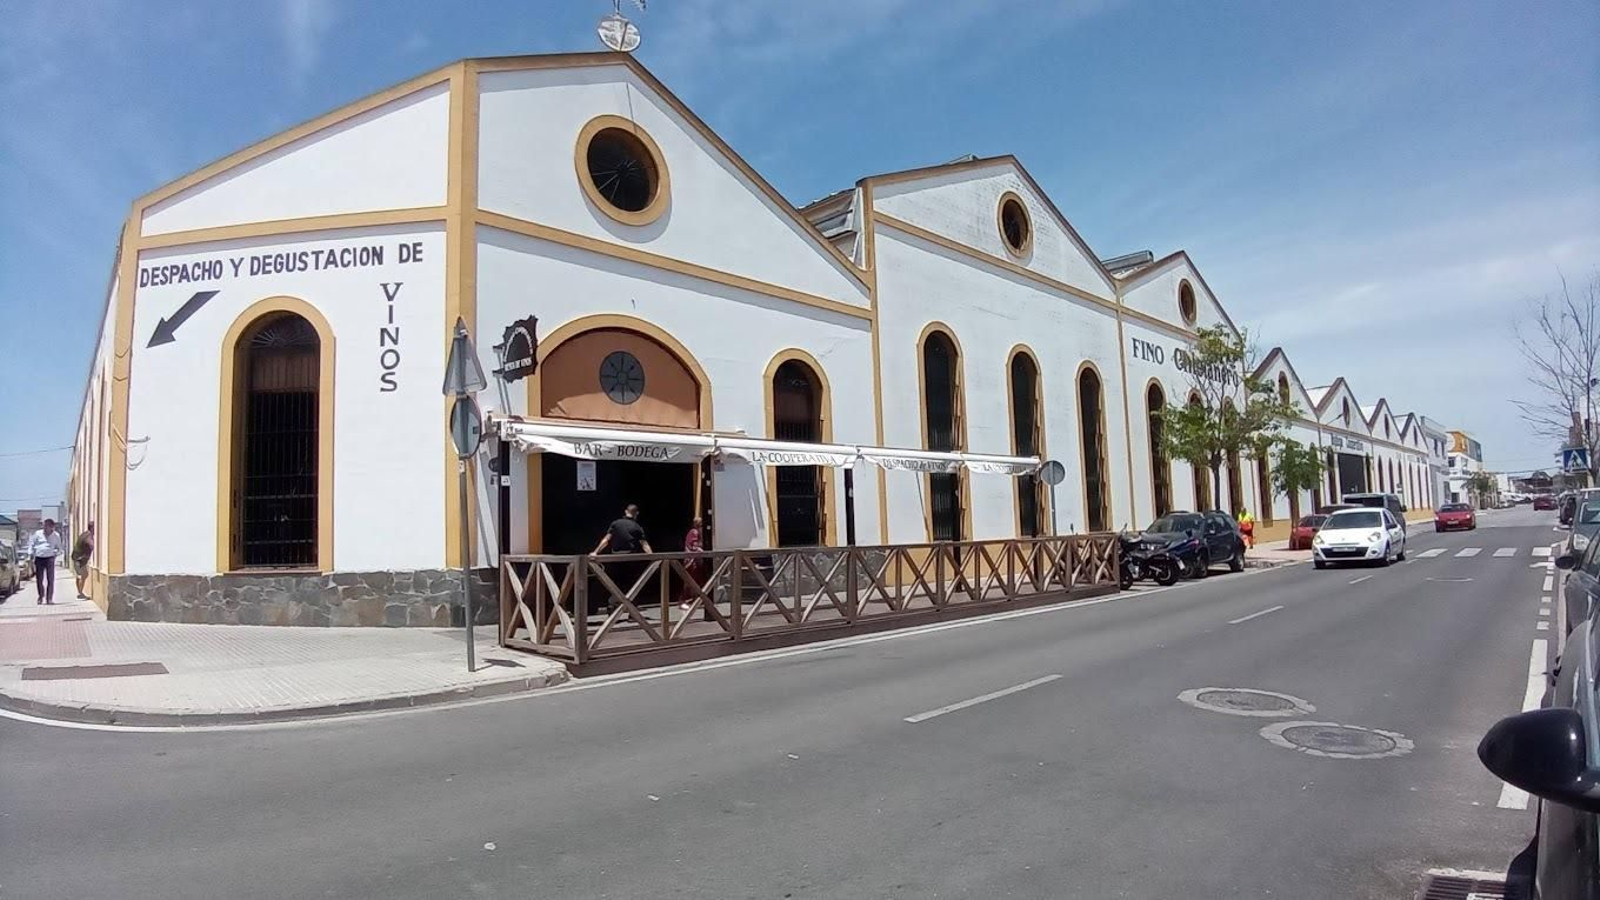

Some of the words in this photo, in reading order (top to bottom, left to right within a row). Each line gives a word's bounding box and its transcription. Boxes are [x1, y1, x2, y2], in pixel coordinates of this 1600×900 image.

[139, 259, 223, 288] DESPACHO
[229, 257, 245, 278] Y
[249, 245, 384, 276] DEGUSTACION
[398, 242, 424, 264] DE
[379, 282, 404, 393] VINOS
[1131, 337, 1165, 365] FINO
[573, 442, 603, 457] BAR
[616, 444, 670, 459] BODEGA
[751, 451, 766, 462] LA
